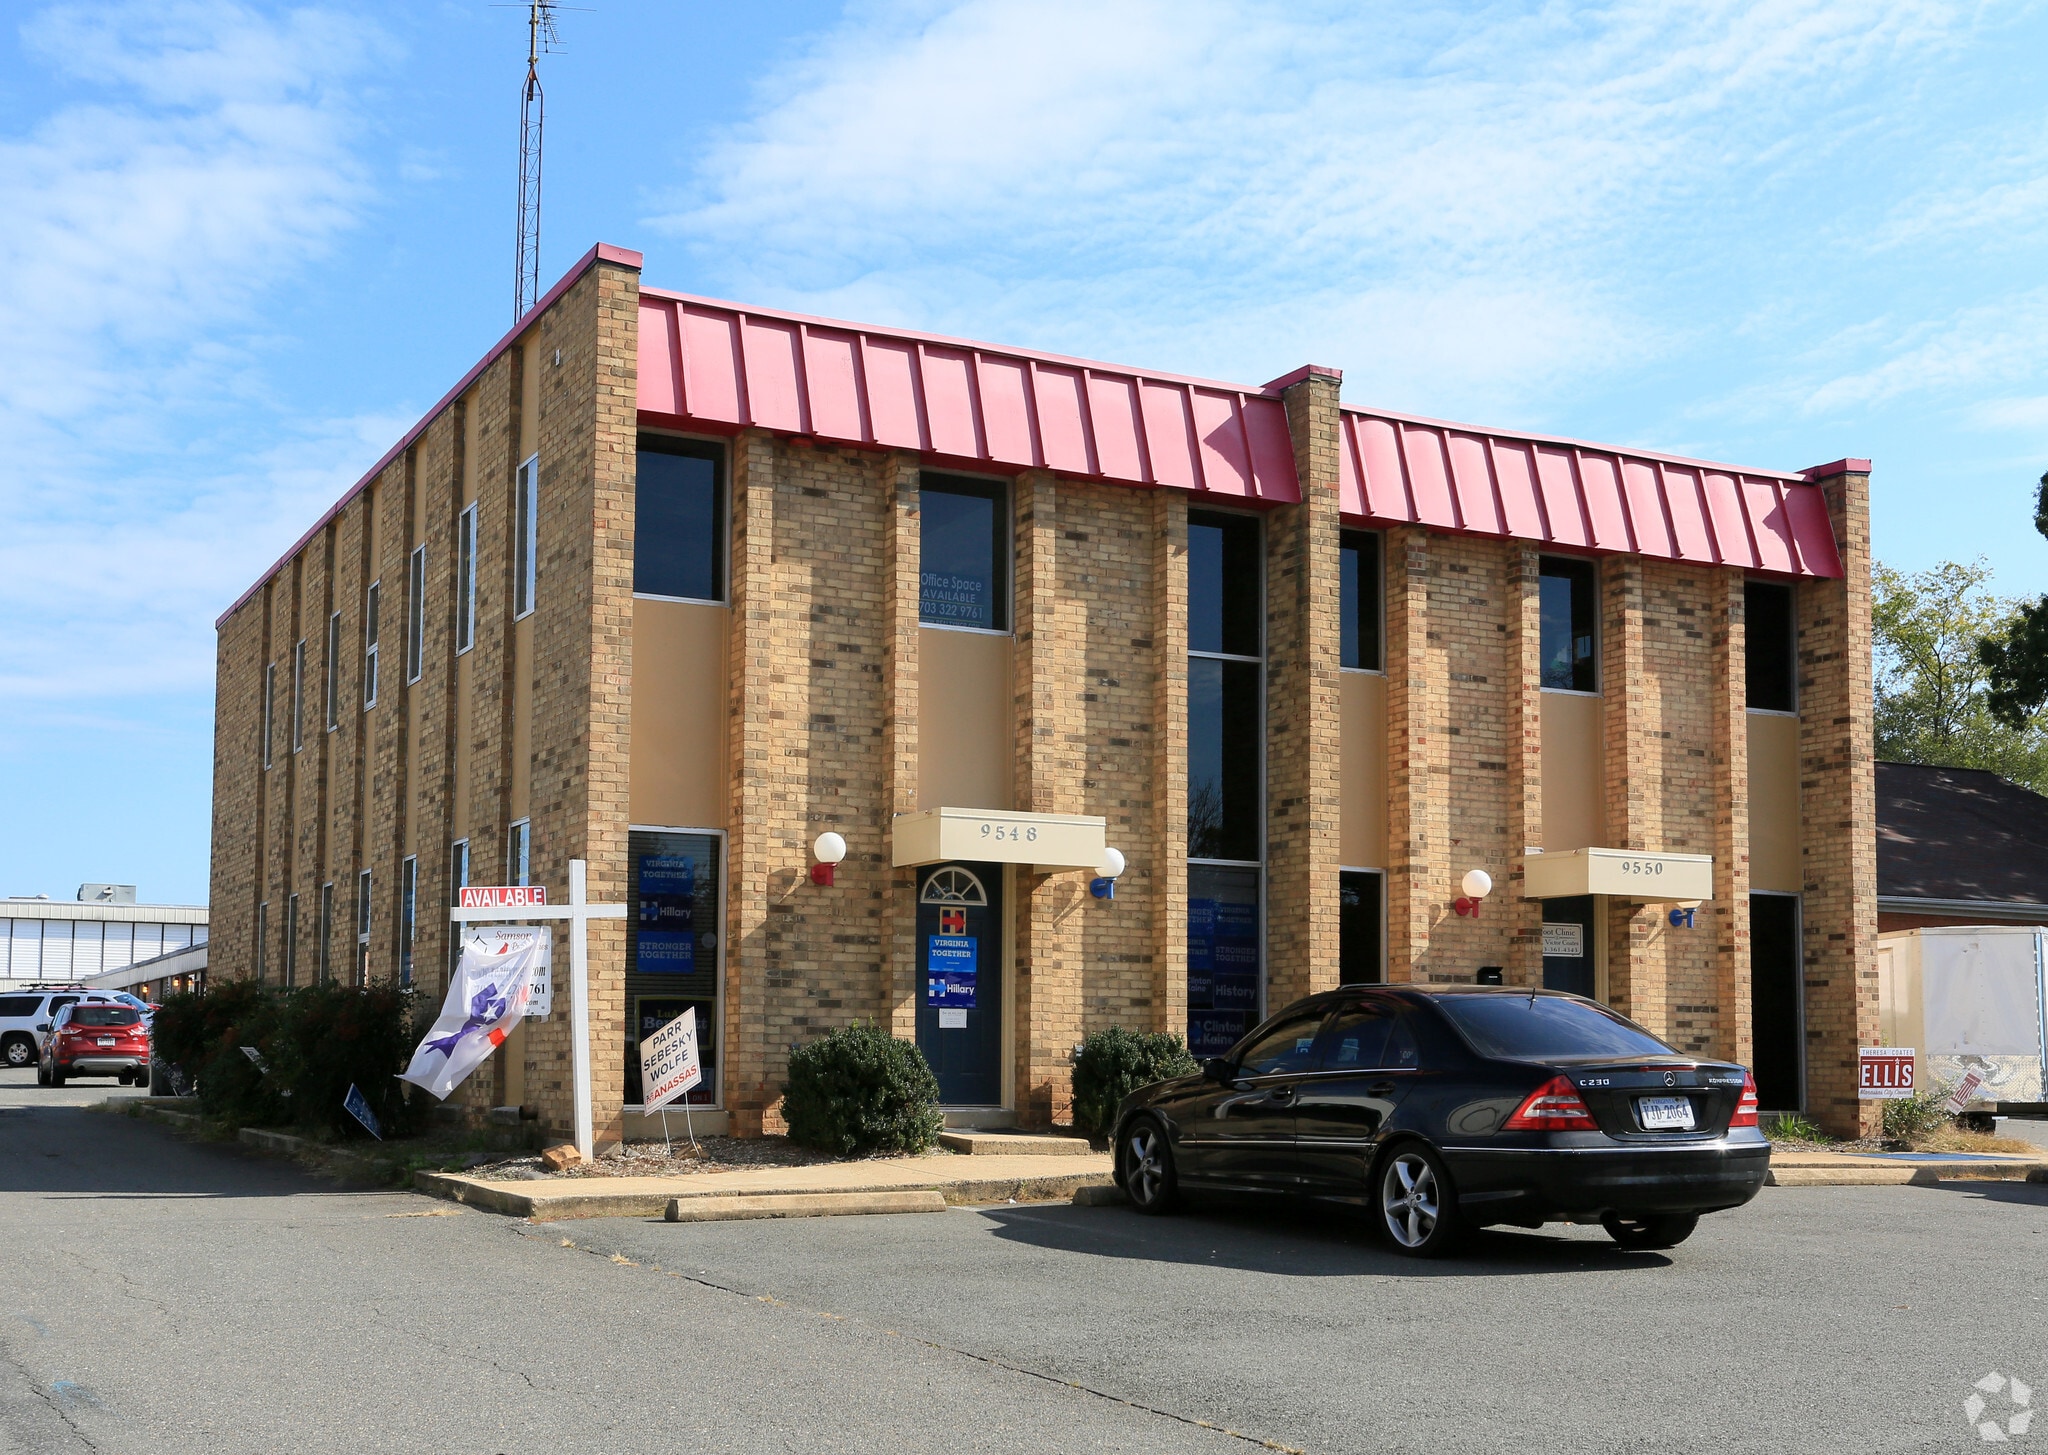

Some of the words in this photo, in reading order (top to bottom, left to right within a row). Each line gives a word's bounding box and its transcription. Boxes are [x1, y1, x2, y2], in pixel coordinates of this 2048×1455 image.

[921, 573, 949, 587] Office
[951, 576, 982, 592] Space
[922, 589, 976, 603] AVAILABLE
[919, 601, 937, 614] 703
[939, 603, 957, 616] 322
[960, 606, 983, 619] 9761
[981, 823, 1038, 842] 9548
[646, 860, 684, 868] VIRGINIA
[1622, 861, 1663, 875] 9550
[643, 871, 688, 879] TOGETHER
[464, 889, 543, 907] AVAILABLE
[660, 907, 692, 919] Hillary
[1543, 928, 1553, 936] oot
[1555, 927, 1576, 936] Clinic
[640, 942, 692, 951] STRONGER
[934, 939, 969, 947] VIRGINIA
[640, 951, 692, 960] TOGETHER
[932, 949, 971, 958] TOGETHER
[1215, 946, 1256, 955] STRONGER
[1215, 954, 1256, 962] TOGETHER
[946, 984, 975, 996] Hillary
[1215, 985, 1256, 1000] History
[1203, 1020, 1243, 1032] Clinton
[653, 1021, 682, 1049] PARR
[1203, 1033, 1235, 1045] Kaine
[644, 1030, 693, 1071] SEBESKY
[650, 1049, 689, 1082] WOLFE
[1861, 1063, 1913, 1087] ELLIS
[1588, 1078, 1610, 1086] 230
[1883, 1088, 1893, 1097] City
